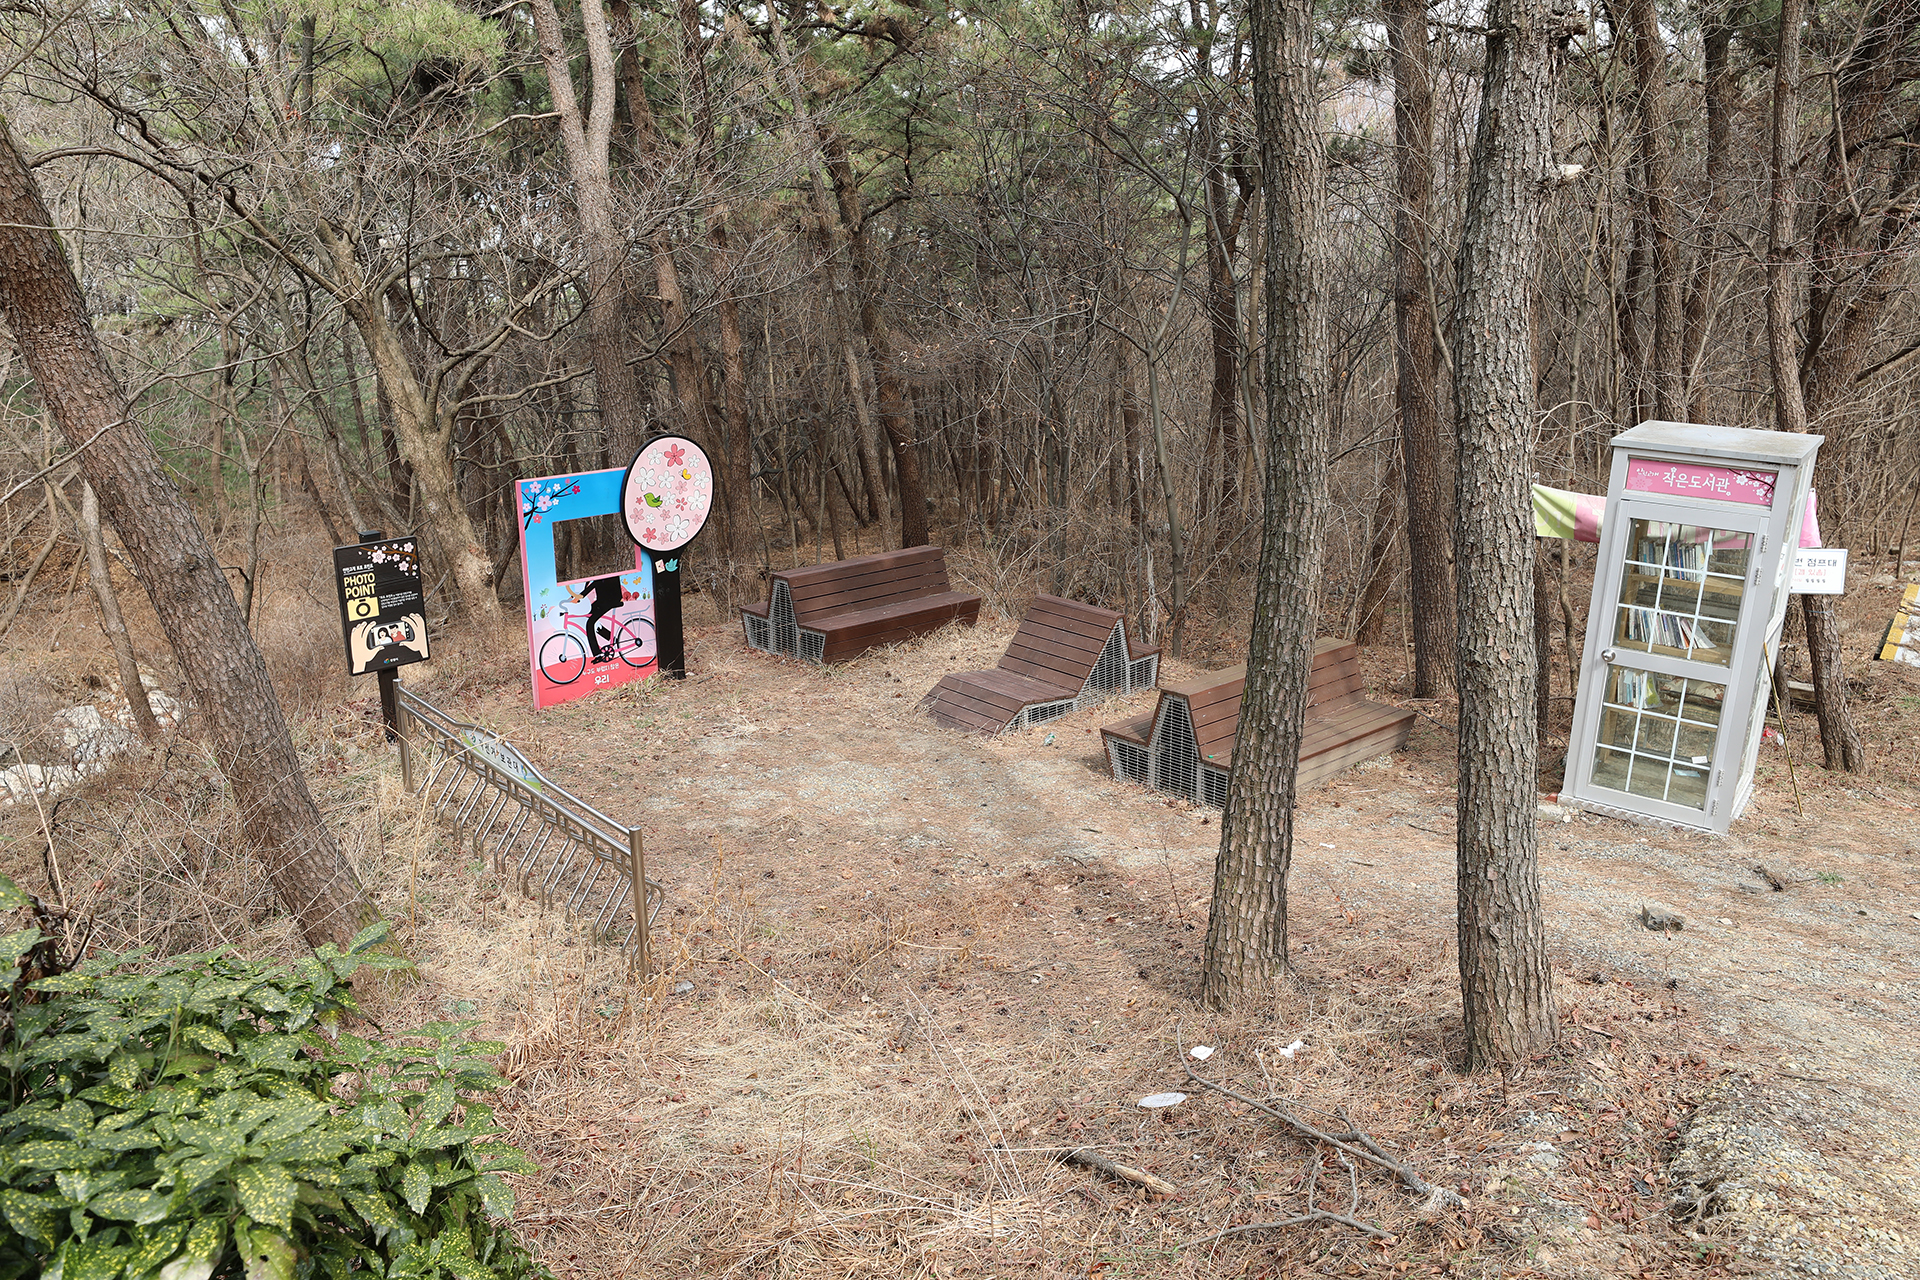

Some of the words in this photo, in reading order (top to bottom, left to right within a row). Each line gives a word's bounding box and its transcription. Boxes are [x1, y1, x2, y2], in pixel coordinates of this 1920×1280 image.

[1662, 471, 1731, 493] 작은도서관
[1807, 557, 1837, 568] 점프대
[344, 572, 375, 587] PHOTO
[345, 583, 376, 599] POINT
[594, 674, 610, 685] 우리
